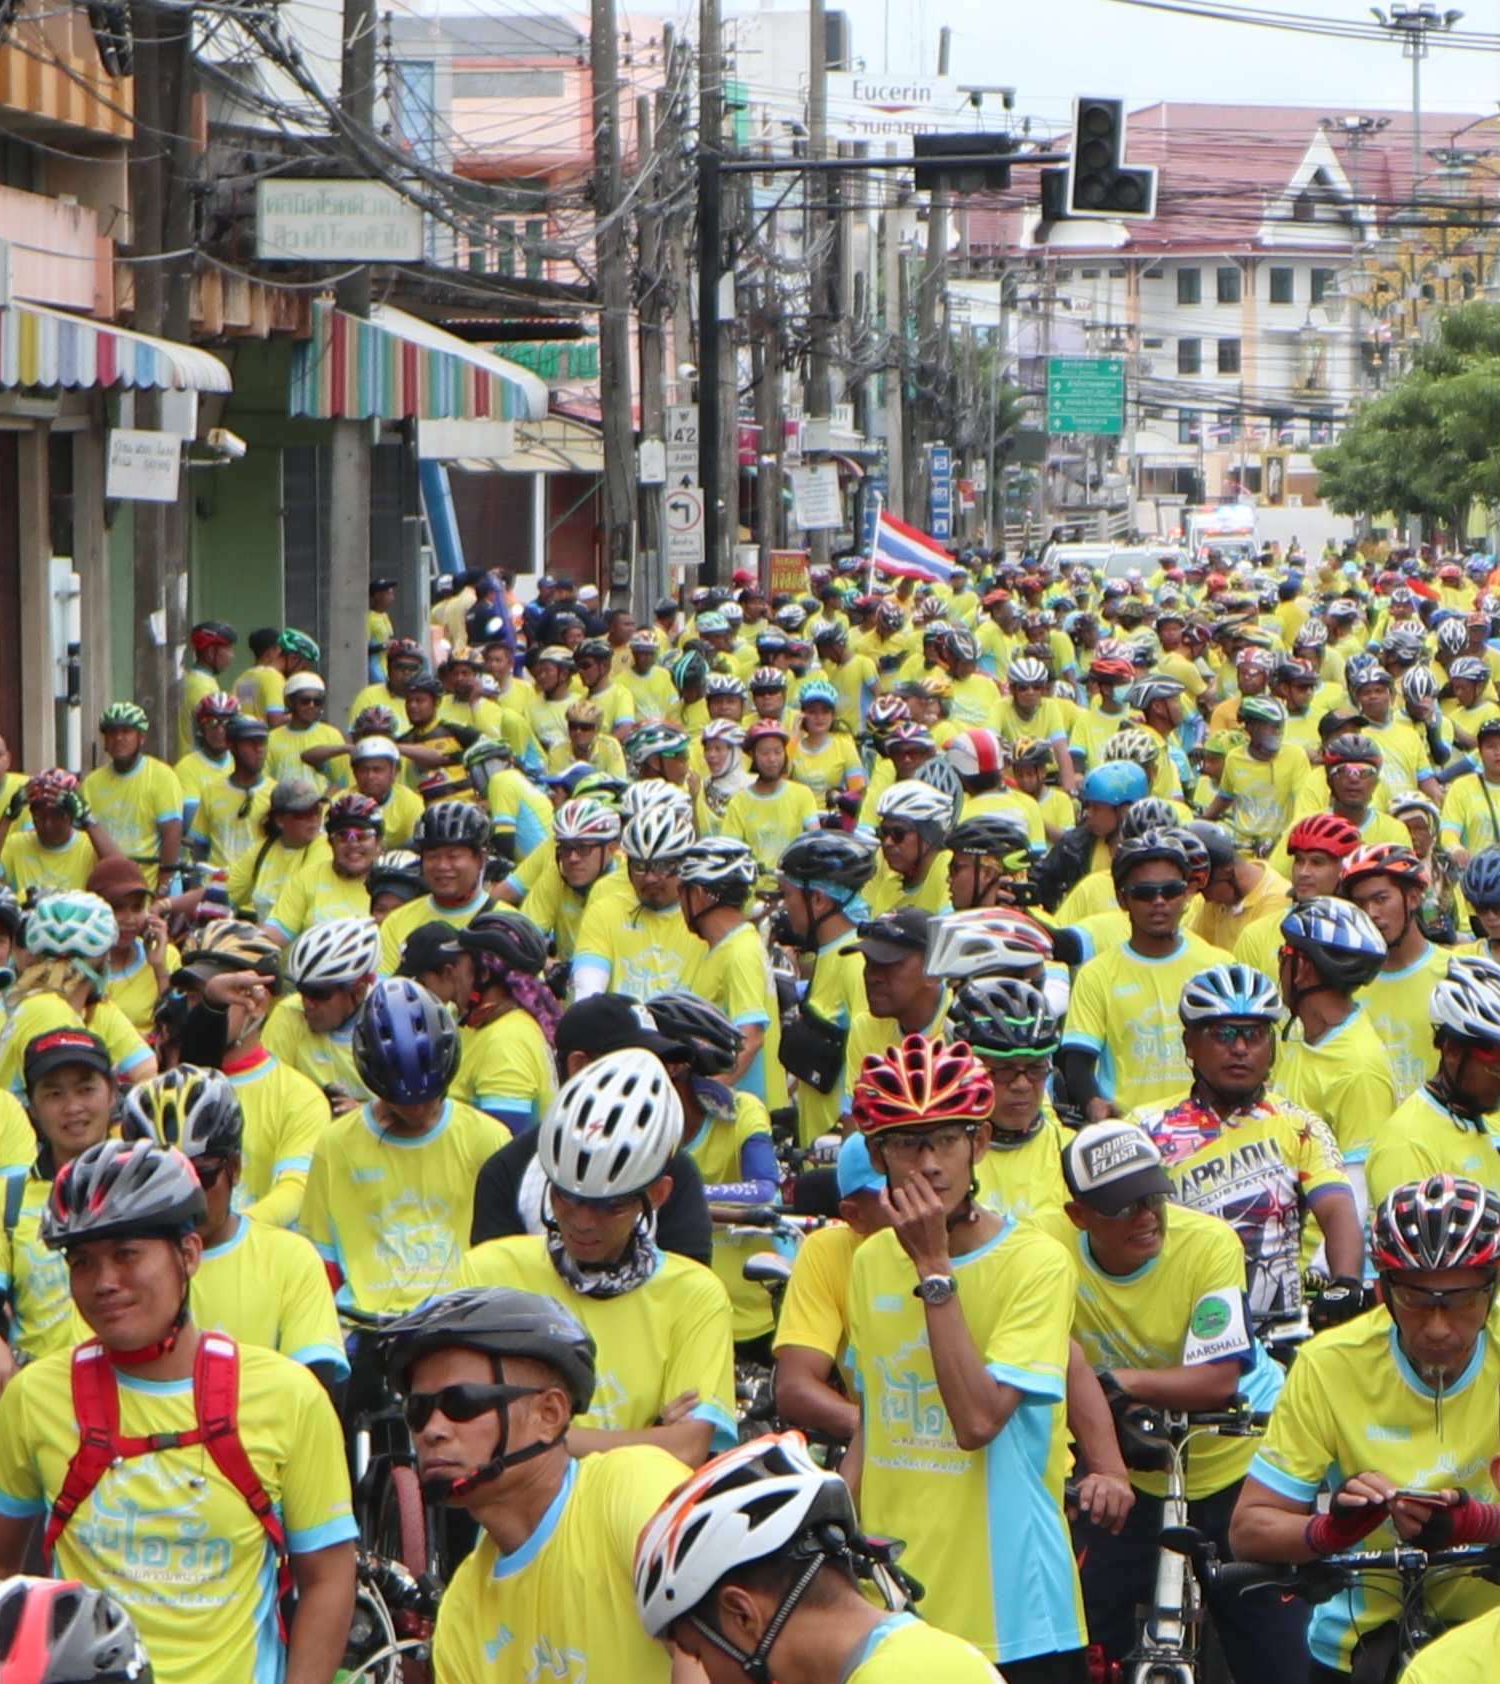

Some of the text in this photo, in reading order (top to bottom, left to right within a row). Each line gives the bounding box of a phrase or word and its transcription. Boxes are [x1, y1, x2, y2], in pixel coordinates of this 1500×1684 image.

[853, 80, 931, 102] Eucerin
[674, 427, 697, 442] 42
[1091, 1144, 1139, 1179] FLASH
[1197, 1185, 1232, 1208] CLUB
[1185, 1336, 1246, 1360] MARSHALL
